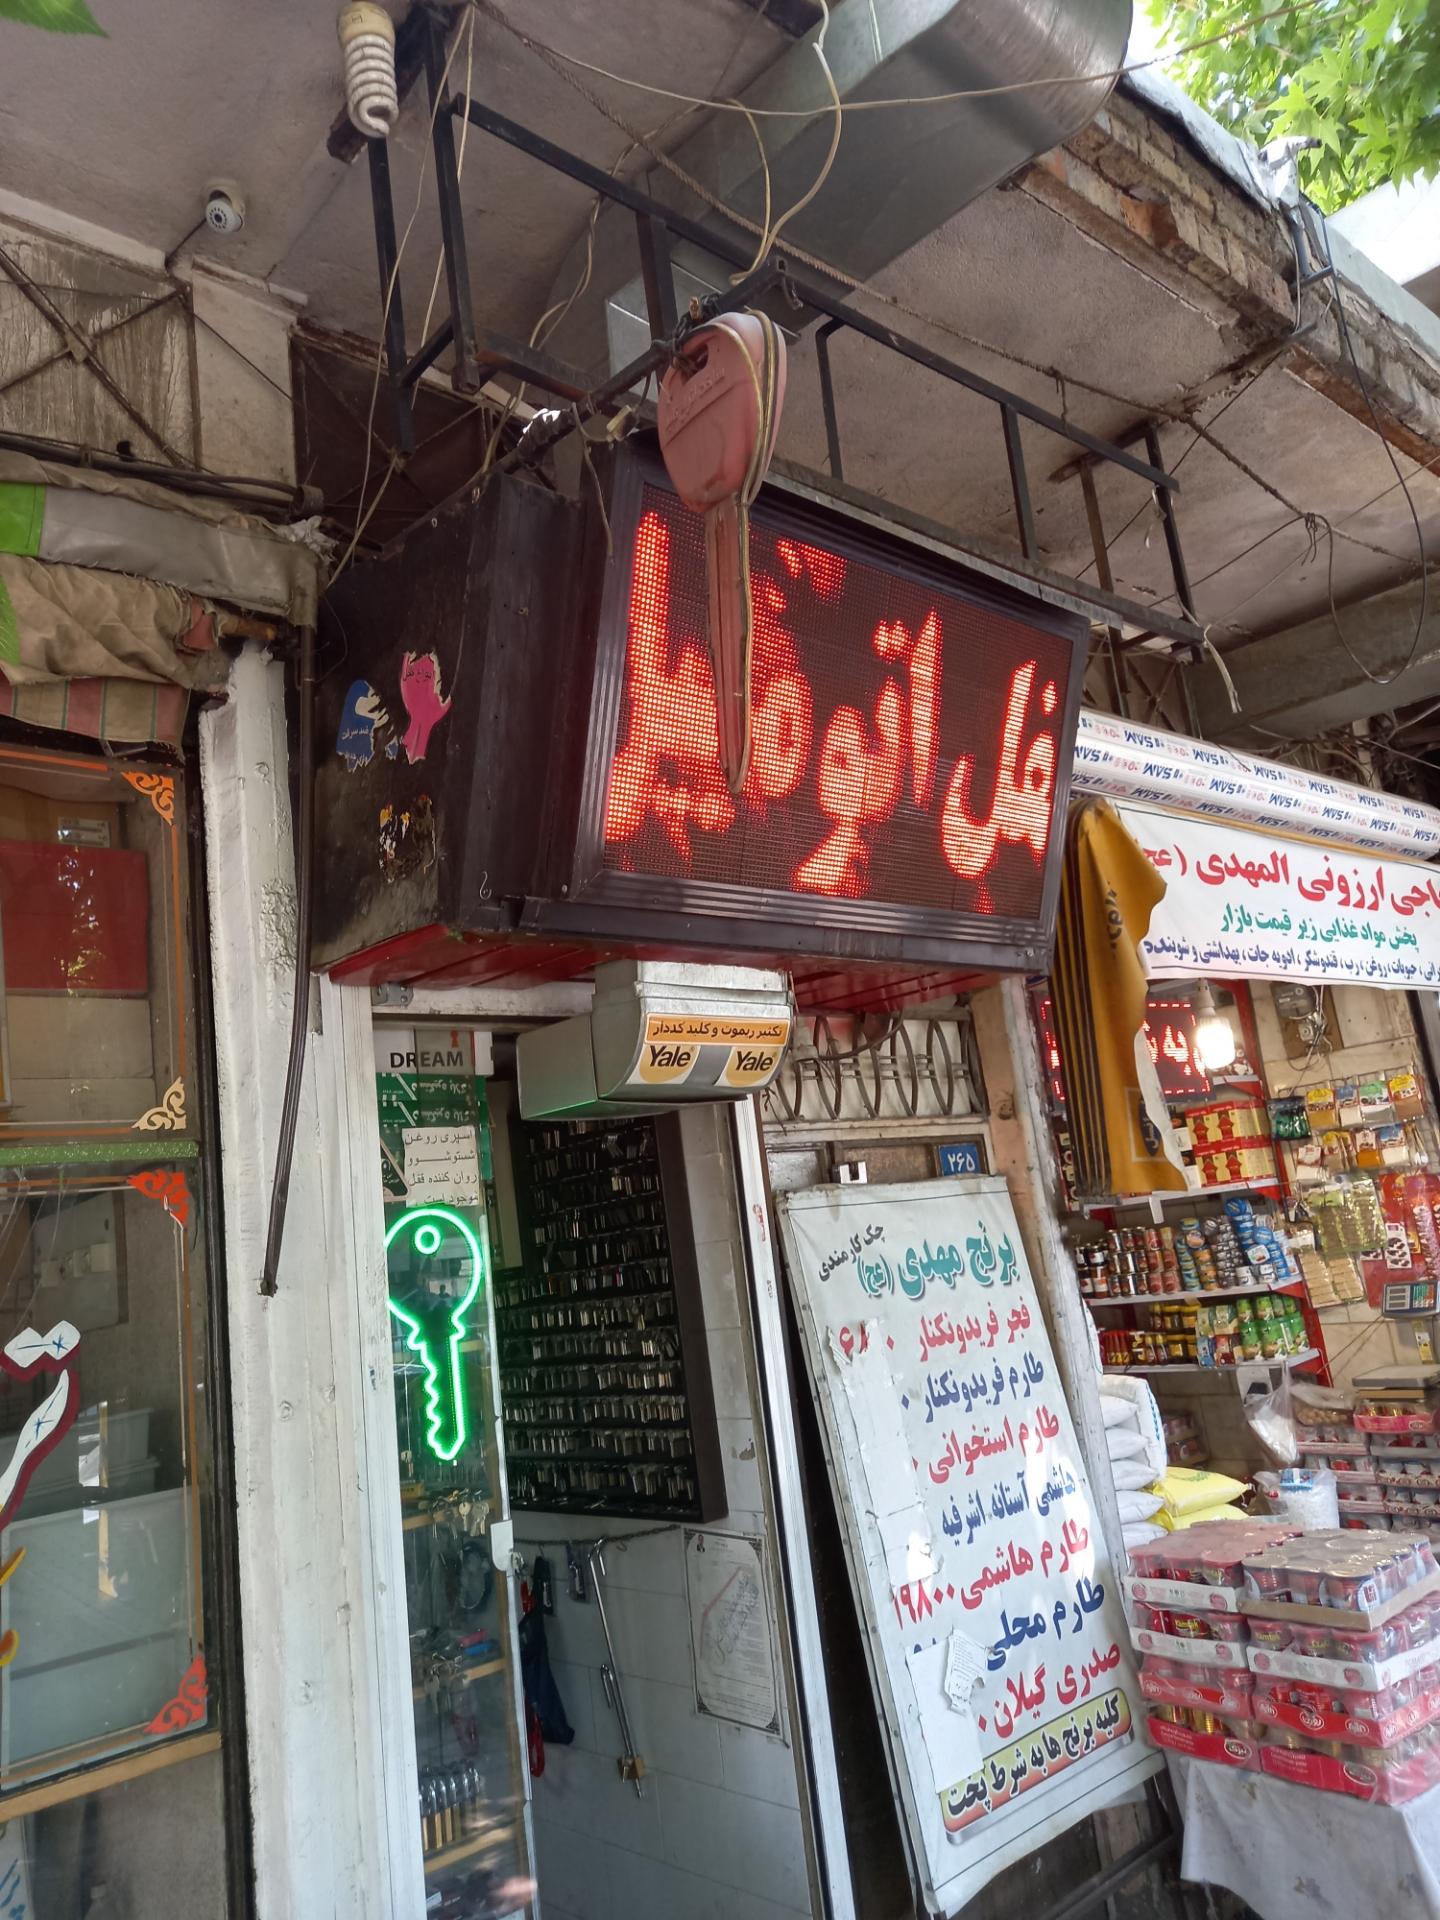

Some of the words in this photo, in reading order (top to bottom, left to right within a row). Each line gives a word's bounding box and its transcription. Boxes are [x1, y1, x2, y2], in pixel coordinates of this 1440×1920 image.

[1196, 850, 1290, 888] المهدی
[1298, 855, 1385, 911] ارزونی
[1391, 878, 1440, 917] اجی
[1221, 903, 1254, 934] بازار
[1255, 908, 1292, 936] قیمت
[1297, 918, 1317, 940] زیر
[1320, 917, 1358, 943] غذایی
[1361, 921, 1386, 948] مواد
[652, 1021, 685, 1036] کددار
[687, 1022, 709, 1035] کلید
[711, 1026, 719, 1037] و
[722, 1025, 755, 1039] ریموت
[757, 1024, 782, 1038] تکثیر
[390, 1051, 464, 1069] DREAM
[649, 1045, 692, 1068] Yale
[735, 1050, 773, 1072] Yale
[404, 1133, 437, 1145] روغن
[440, 1130, 473, 1144] اسپری
[407, 1171, 425, 1187] قفل
[428, 1171, 450, 1184] کننده
[453, 1170, 478, 1185] روان
[948, 1151, 976, 1171] ۲۶۵
[899, 1239, 964, 1299] مهدی
[965, 1220, 1020, 1287] برنج
[856, 1253, 895, 1298] (عج)
[1007, 1295, 1031, 1342] فجر
[1009, 1351, 1044, 1400] طارم
[1019, 1405, 1060, 1456] طارم
[928, 1415, 1014, 1484] استخوانی
[992, 1470, 1030, 1519] آستانه
[942, 1489, 986, 1547] اشرفیه
[1040, 1519, 1089, 1579] طارم
[961, 1541, 1034, 1611] هاشمی
[892, 1579, 955, 1630] ۱۹۸۰۰
[1053, 1575, 1105, 1640] طارم
[985, 1609, 1047, 1672] محلی
[1056, 1642, 1121, 1705] صدری
[993, 1662, 1047, 1738] گیلان
[1095, 1695, 1120, 1731] کلیه
[1048, 1732, 1062, 1760] ها
[1064, 1716, 1094, 1758] برنج
[991, 1747, 1028, 1796] شرط
[1030, 1738, 1048, 1774] به
[948, 1775, 993, 1812] پخت
